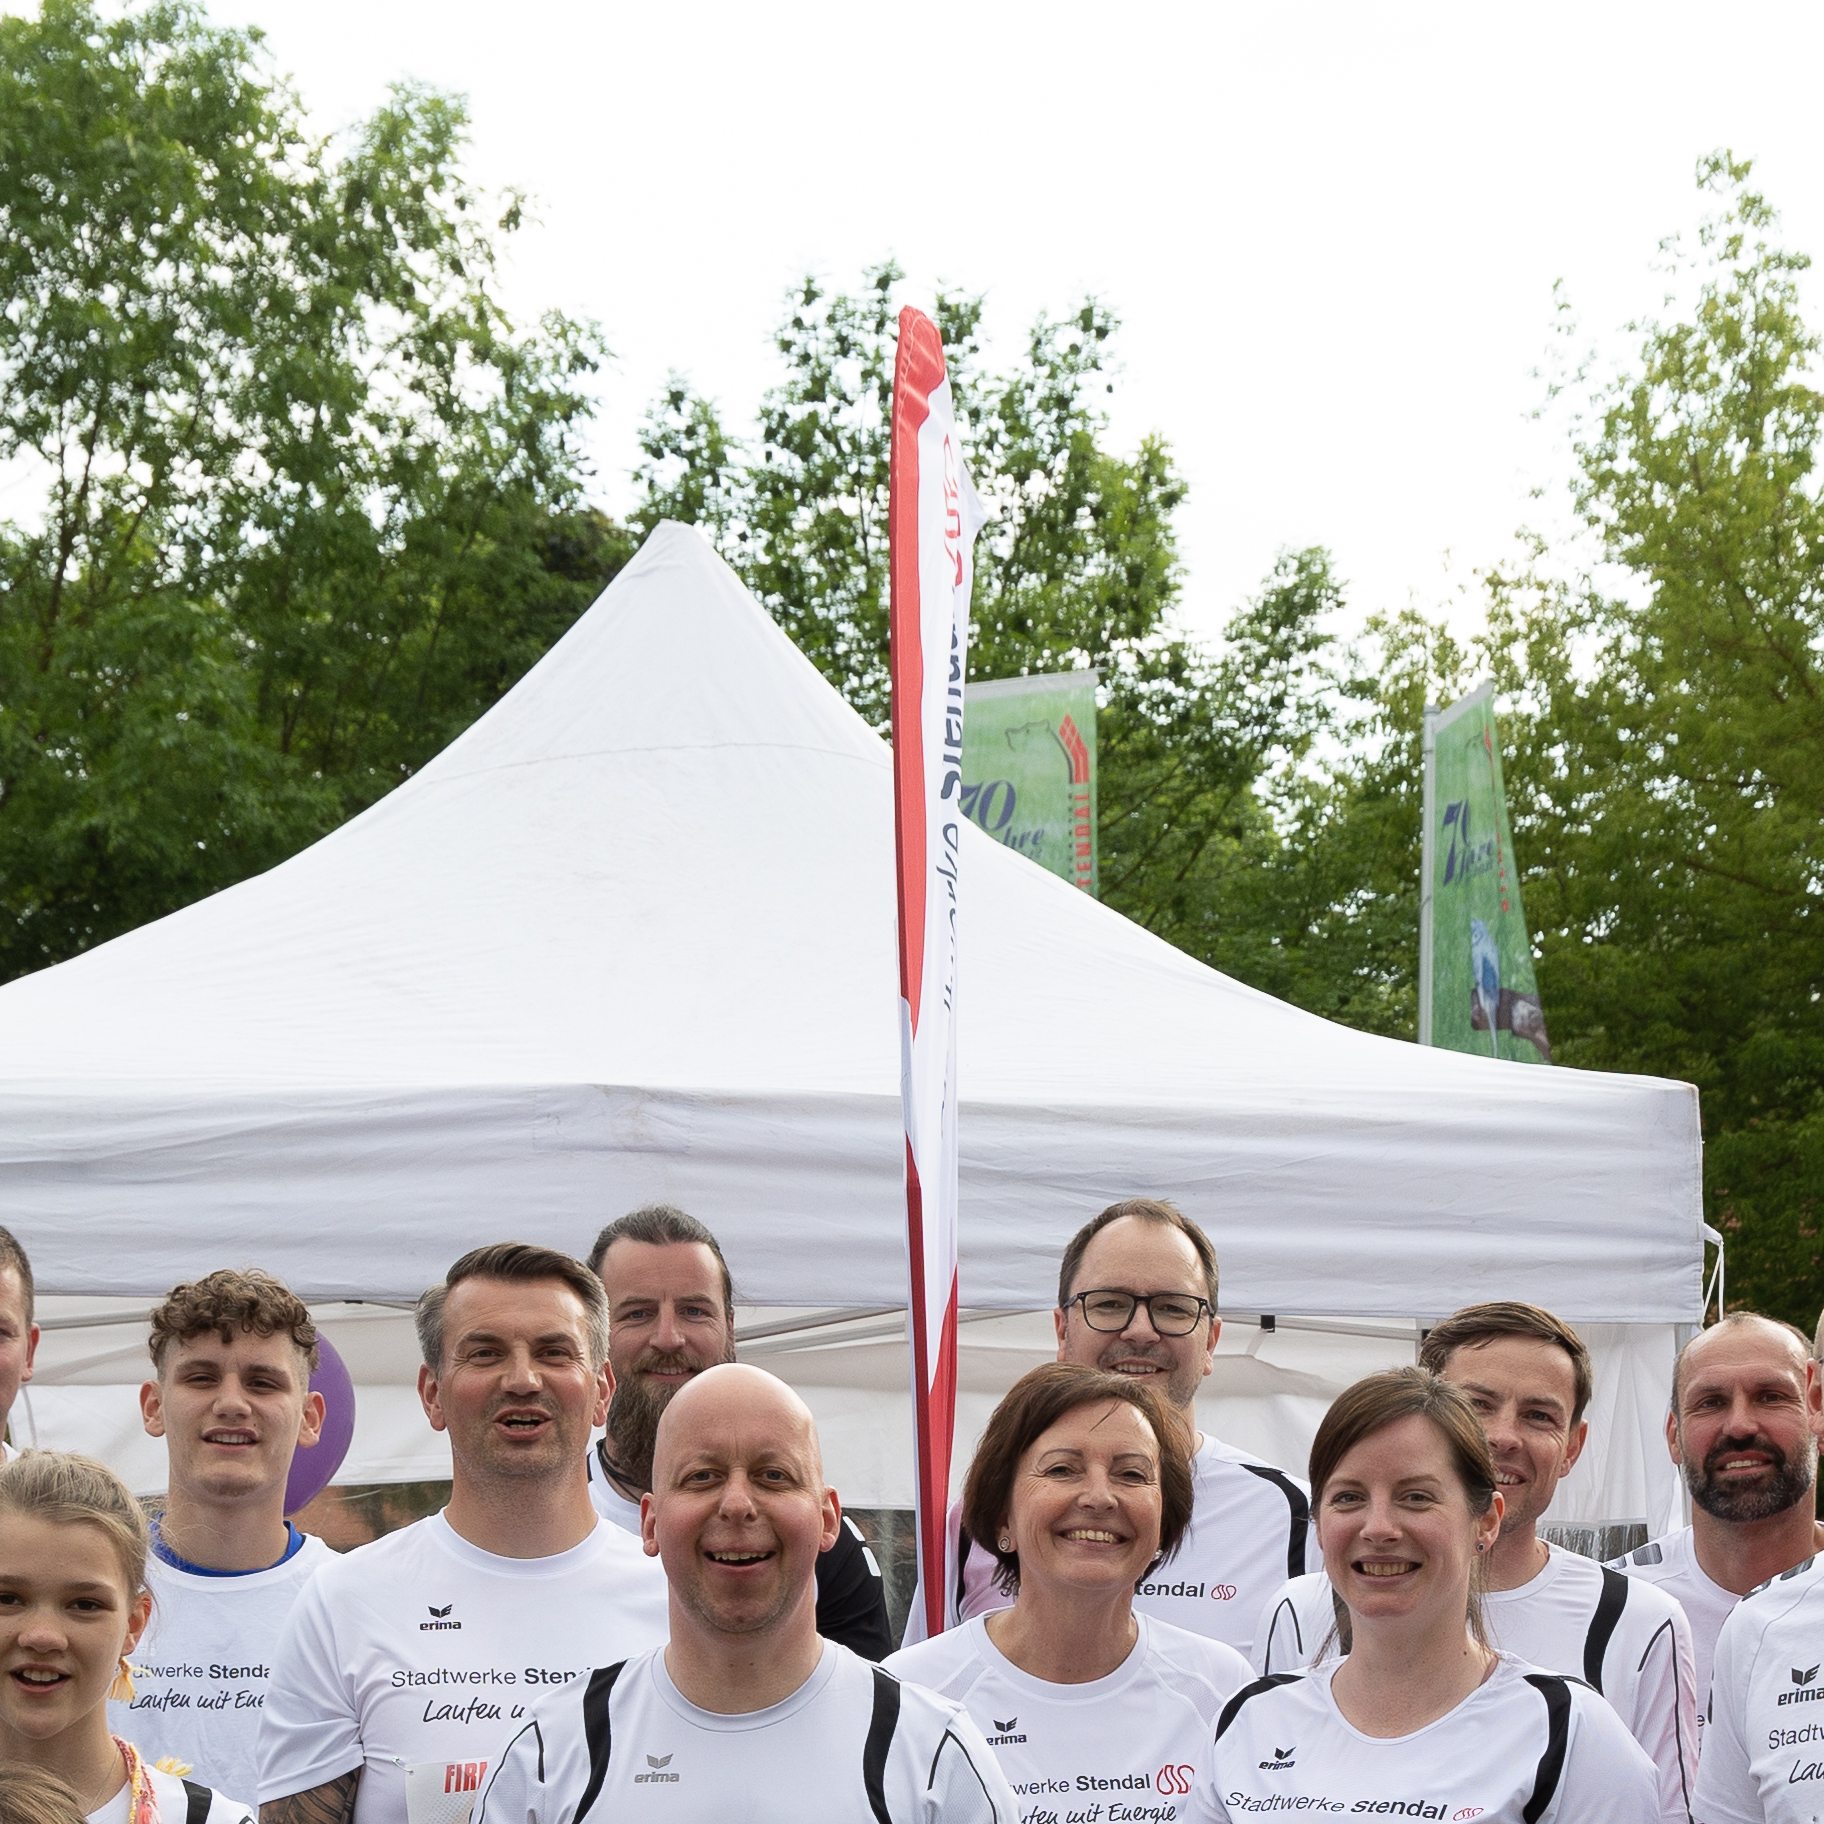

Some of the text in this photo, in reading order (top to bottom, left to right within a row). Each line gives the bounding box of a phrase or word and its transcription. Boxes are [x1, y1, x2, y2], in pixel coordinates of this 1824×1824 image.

[1074, 793, 1092, 898] TENDAL
[1135, 1581, 1205, 1598] tendal
[419, 1620, 462, 1631] erima
[391, 1667, 517, 1688] Stadtwerke
[196, 1689, 232, 1711] mit
[422, 1696, 502, 1725] Laufen
[1258, 1759, 1296, 1771] erima
[634, 1770, 680, 1783] erima
[1075, 1773, 1151, 1793] Stendal
[1065, 1802, 1104, 1824] mit
[1225, 1790, 1448, 1821] Stadtwerke Stendal
